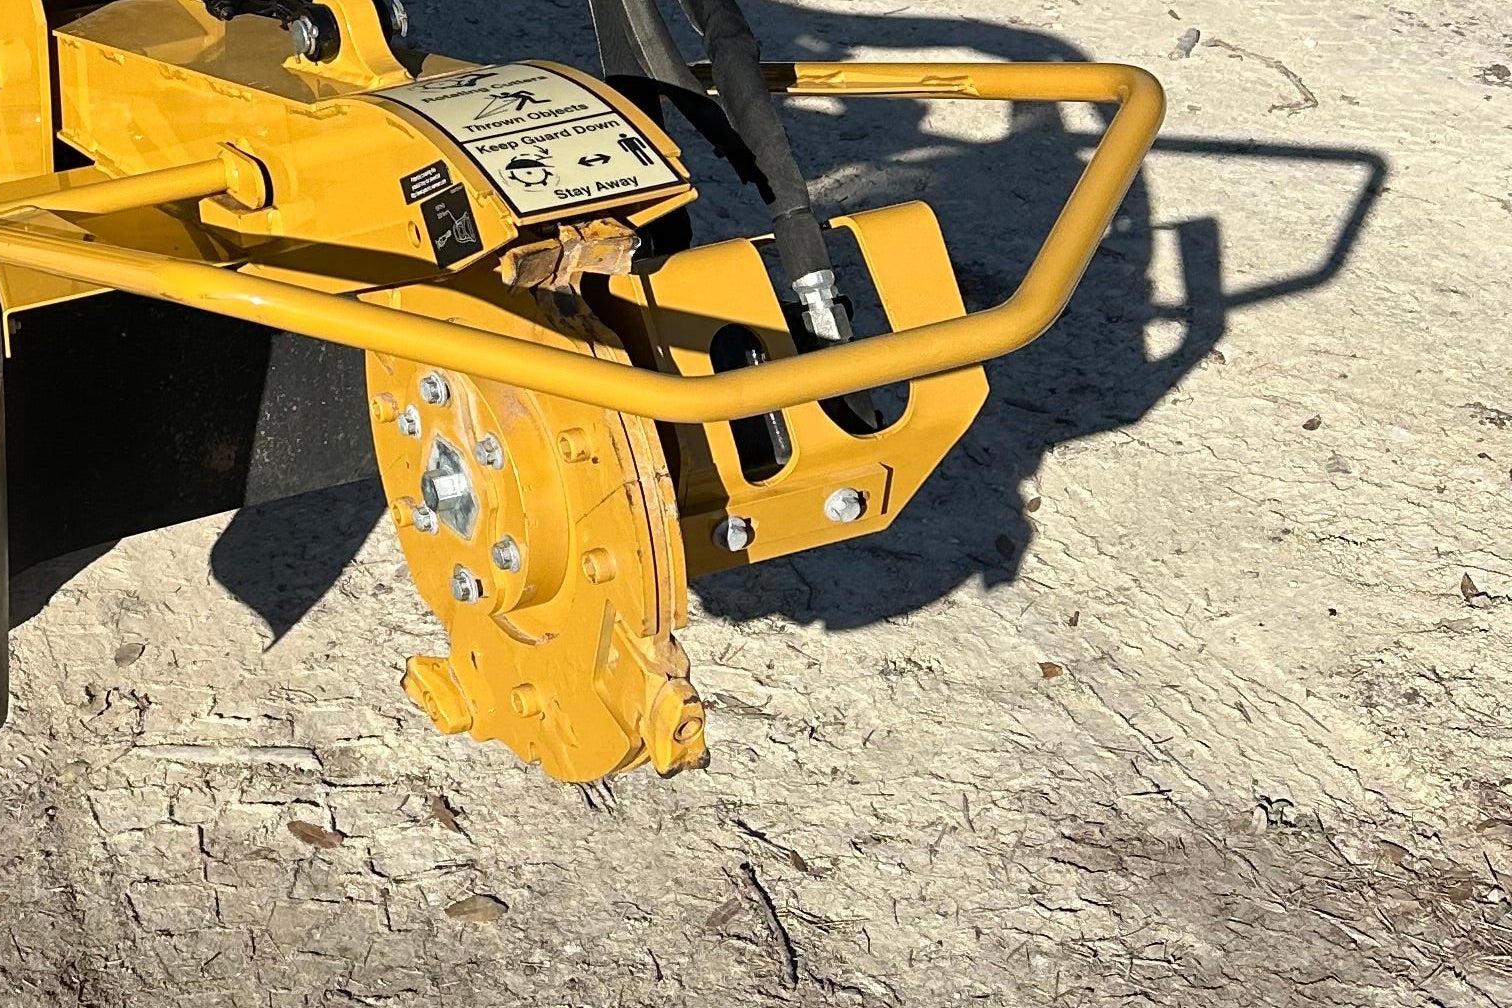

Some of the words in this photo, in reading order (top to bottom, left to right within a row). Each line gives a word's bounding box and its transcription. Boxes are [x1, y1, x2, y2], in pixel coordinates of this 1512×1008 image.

[421, 87, 490, 104] Rotating
[490, 74, 549, 90] Cutters
[462, 114, 525, 134] Thrown
[528, 103, 590, 121] Objects
[475, 140, 519, 155] Keep
[520, 128, 571, 146] Guard
[572, 118, 621, 135] Down
[554, 182, 593, 201] Stay
[596, 174, 640, 193] Away
